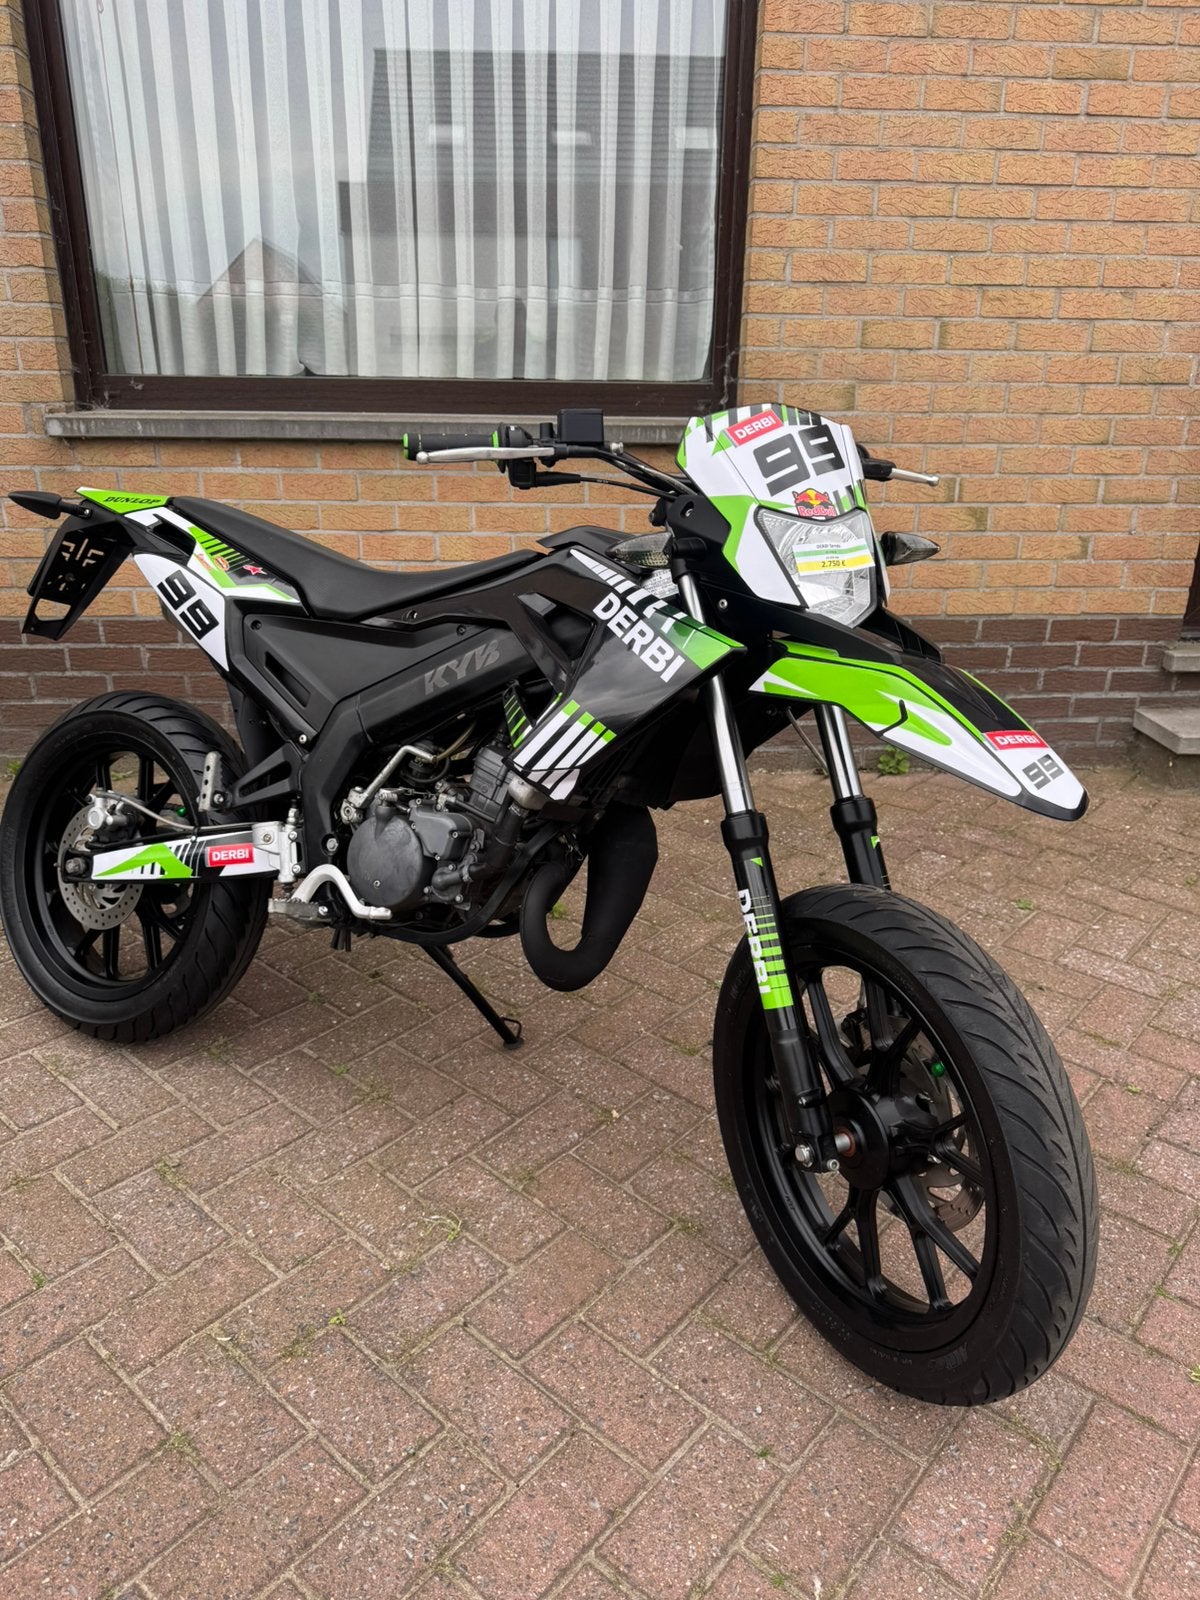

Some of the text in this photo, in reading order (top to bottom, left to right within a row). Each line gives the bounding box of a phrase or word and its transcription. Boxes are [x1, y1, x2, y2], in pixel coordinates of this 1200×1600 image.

[734, 415, 777, 440] DERBI
[753, 424, 846, 497] 99
[103, 496, 161, 505] DUNLOP
[821, 560, 840, 568] 2.750
[157, 569, 220, 641] 99
[592, 592, 686, 683] DERBI
[424, 639, 500, 696] KYB
[994, 734, 1039, 747] DERBI
[1021, 753, 1065, 790] 99
[211, 849, 250, 862] DERBI
[737, 888, 772, 994] DERBI
